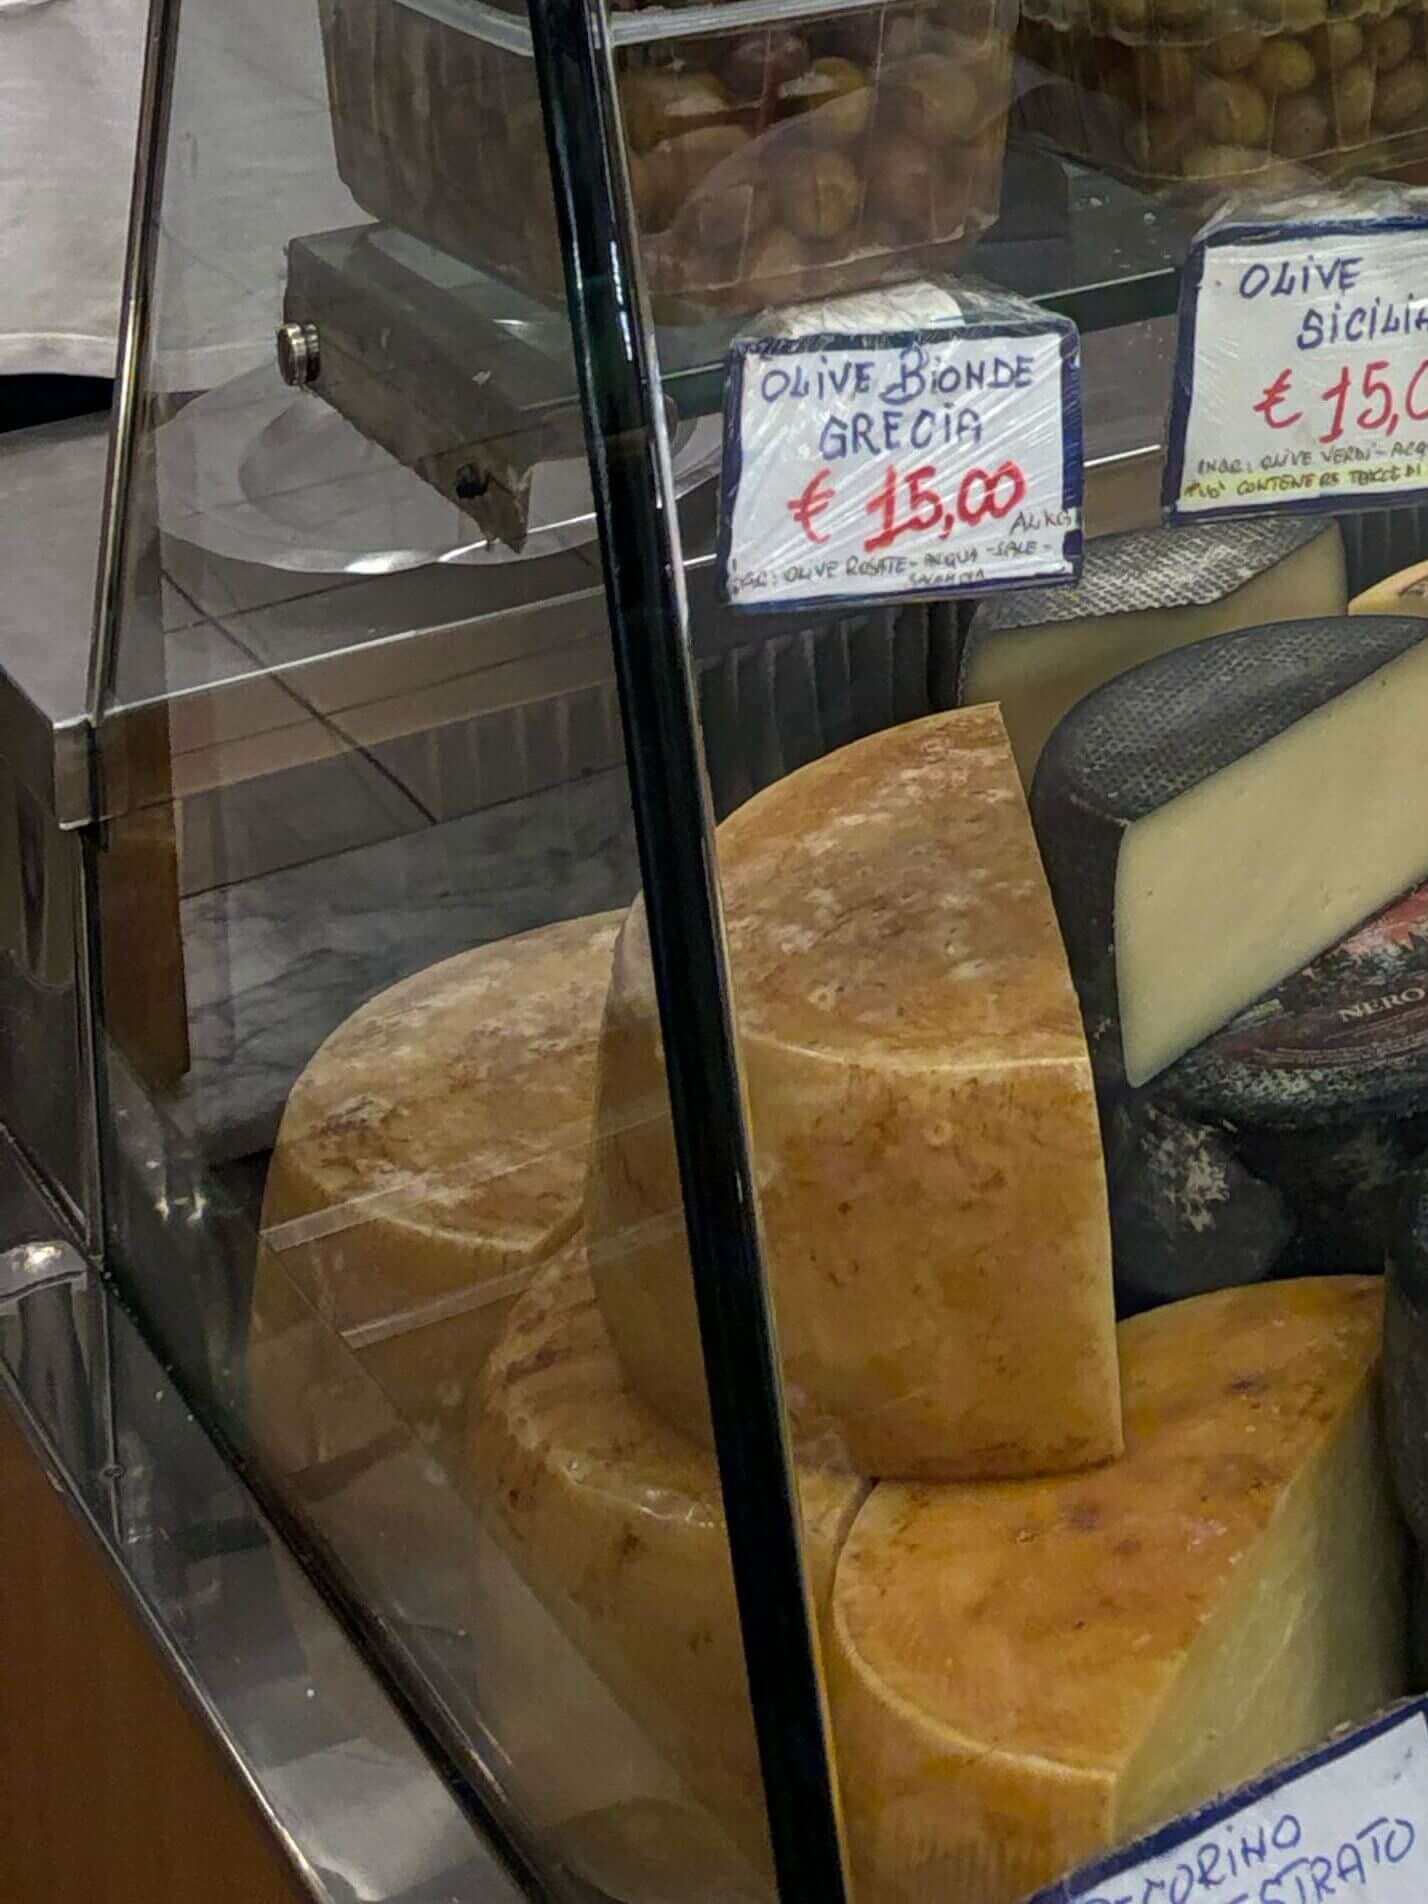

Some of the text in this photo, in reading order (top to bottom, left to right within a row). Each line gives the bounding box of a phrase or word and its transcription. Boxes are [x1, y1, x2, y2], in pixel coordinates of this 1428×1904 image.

[1239, 255, 1365, 299] OLIVE
[760, 347, 1035, 406] OLIVE BIONDE
[1252, 368, 1304, 430] €
[819, 403, 983, 462] GRECIA
[787, 459, 1027, 553] € 15,00
[1338, 987, 1426, 1022] NERO
[1085, 1813, 1303, 1904] CORINO
